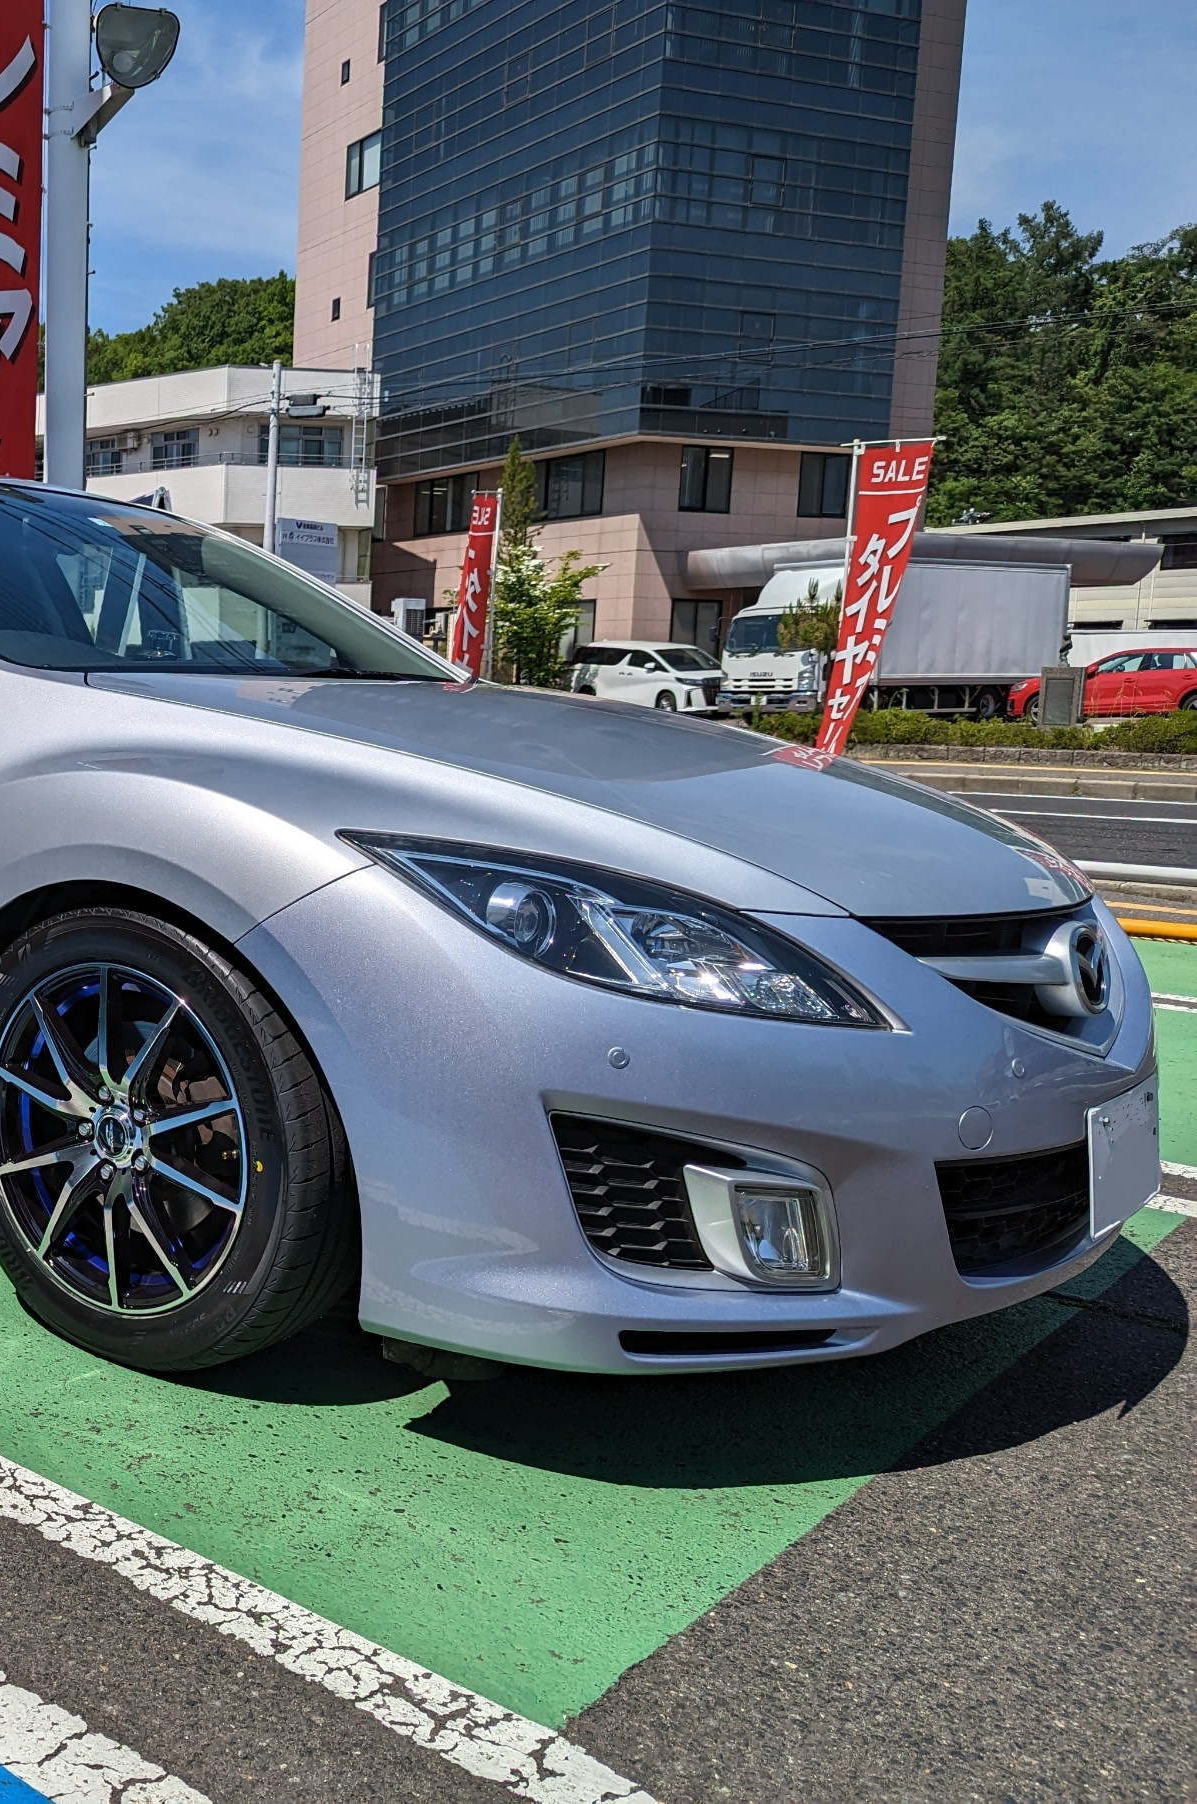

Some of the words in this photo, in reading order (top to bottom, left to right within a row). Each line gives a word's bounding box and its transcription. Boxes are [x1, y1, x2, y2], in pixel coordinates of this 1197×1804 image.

[871, 456, 929, 484] SALE
[820, 533, 887, 753] タイヤセー
